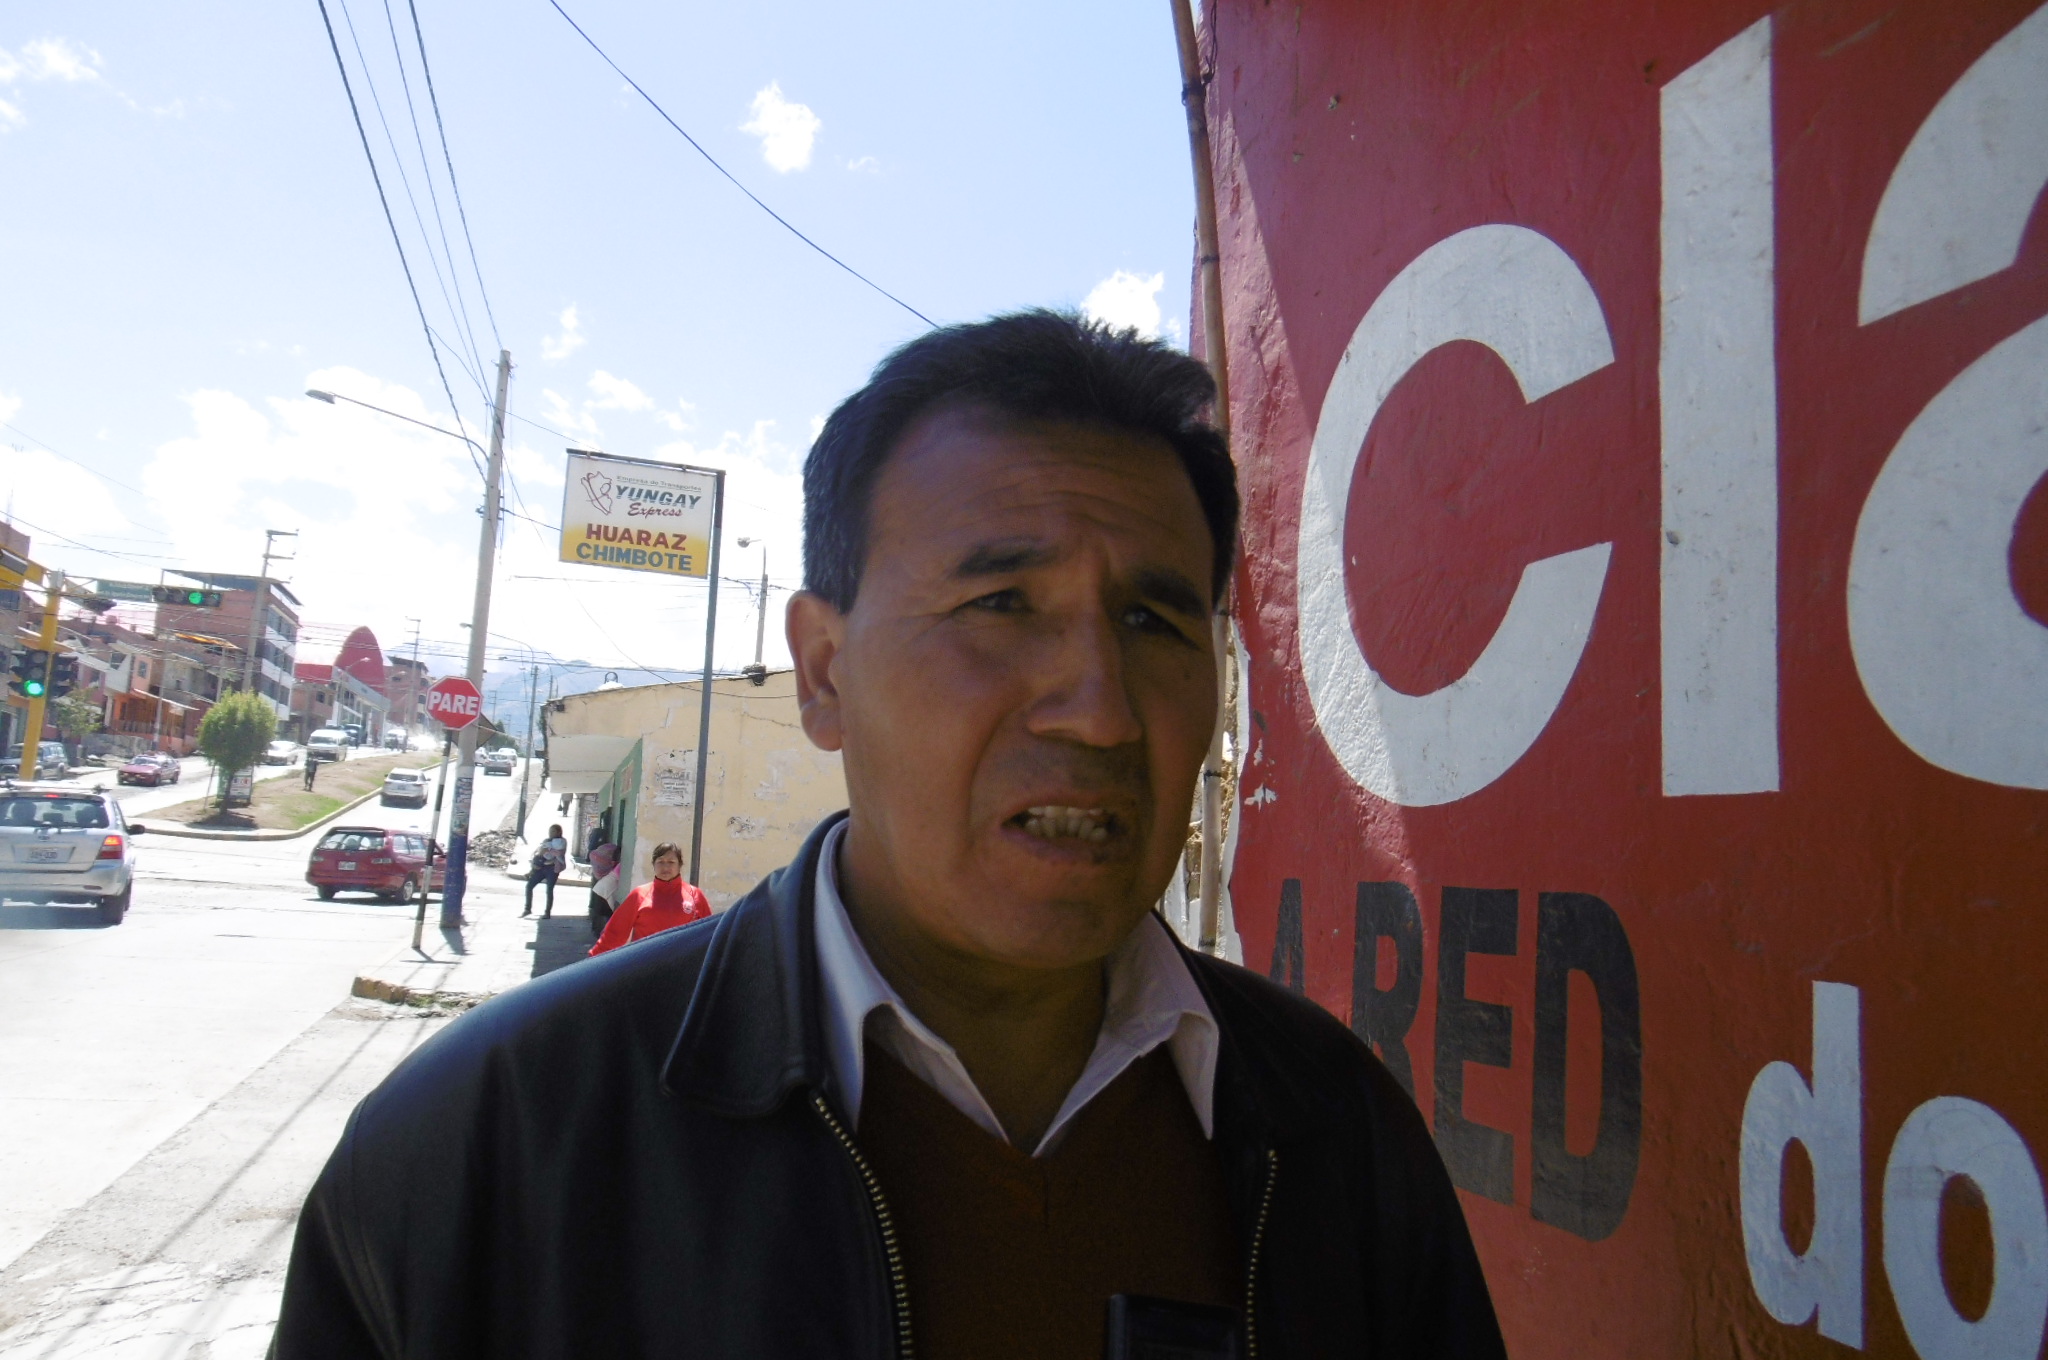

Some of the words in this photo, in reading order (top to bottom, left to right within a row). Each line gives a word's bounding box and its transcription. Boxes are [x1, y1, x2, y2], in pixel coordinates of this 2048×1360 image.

[616, 475, 648, 485] Empresa
[661, 481, 702, 491] Transportes
[616, 485, 701, 509] YUNGAY
[627, 502, 682, 519] Express
[586, 523, 687, 551] HUARAZ
[576, 542, 693, 571] CHIMBOTE
[428, 691, 479, 716] PARE
[1351, 881, 1642, 1242] RED
